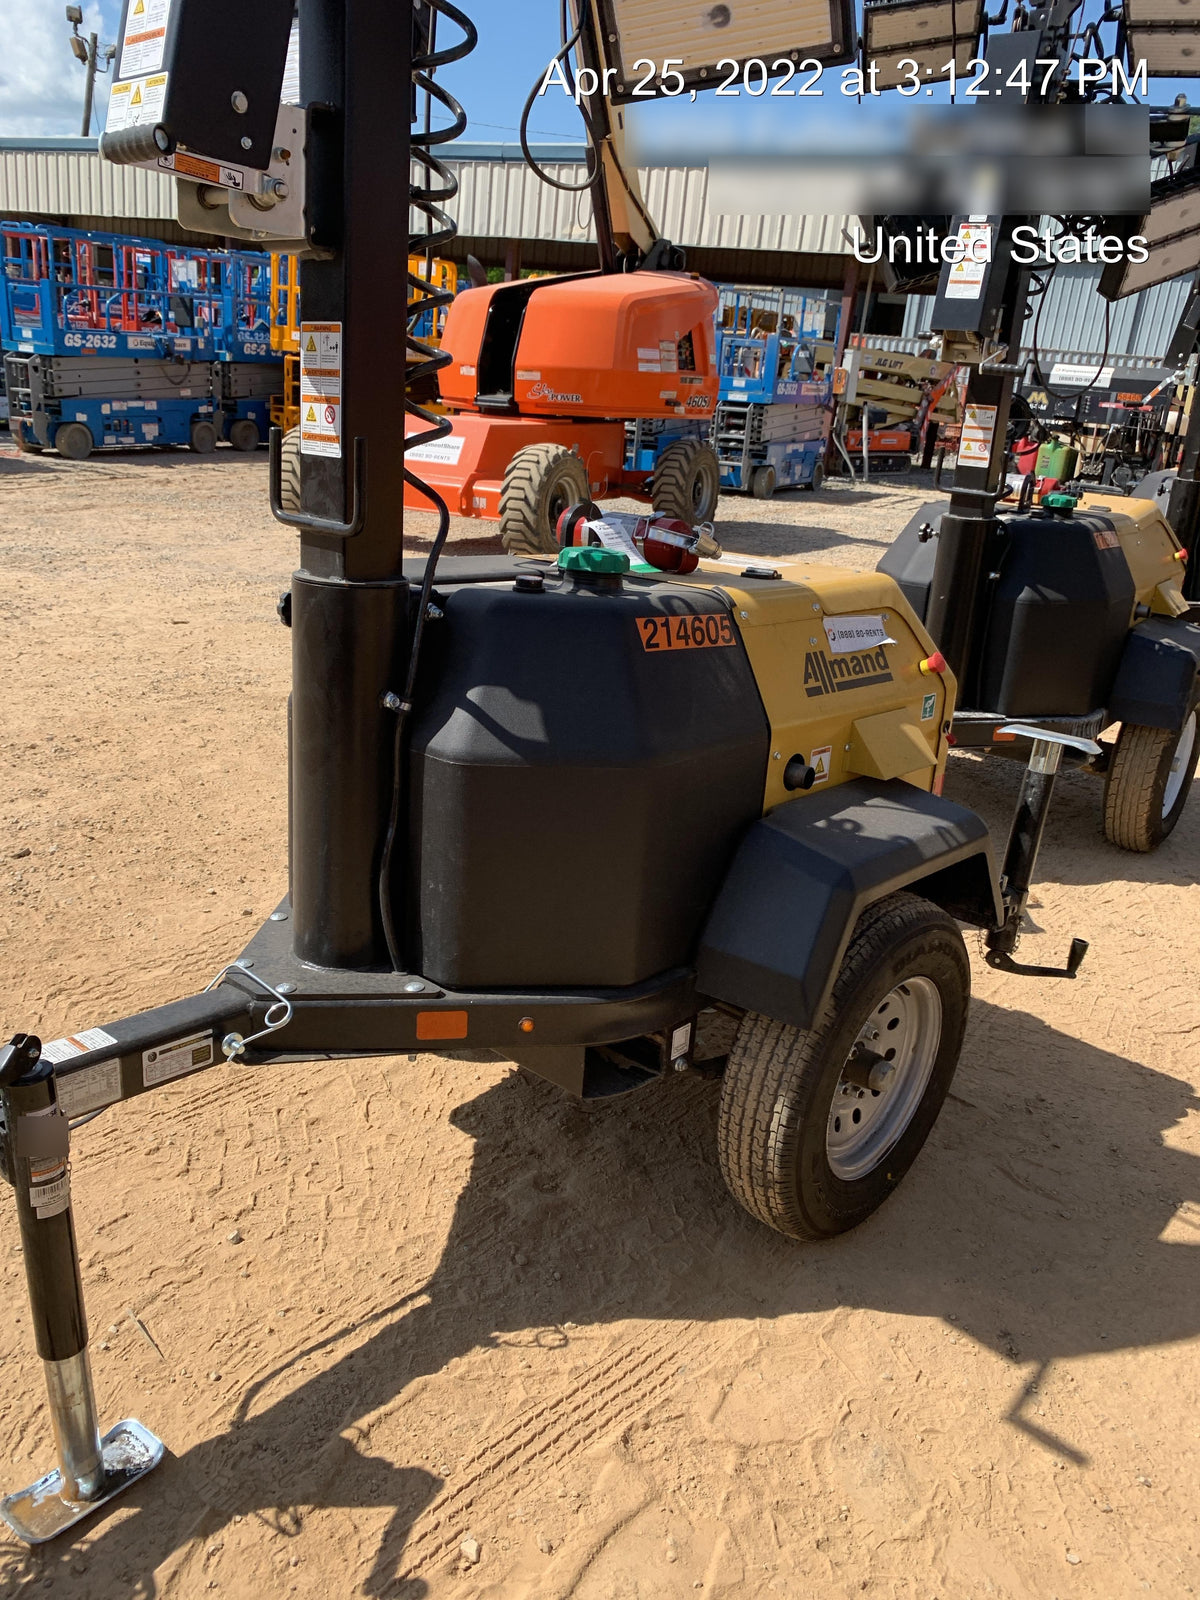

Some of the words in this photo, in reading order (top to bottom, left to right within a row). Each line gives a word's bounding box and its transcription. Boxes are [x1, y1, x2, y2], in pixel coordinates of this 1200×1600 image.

[64, 333, 117, 349] GS-2632
[875, 357, 889, 367] JLG
[889, 359, 904, 369] LIFT
[549, 393, 581, 402] POWER
[643, 615, 735, 649] 214605
[837, 628, 855, 640] (888)
[855, 628, 885, 639] 80-RENTS
[803, 643, 890, 694] Allmand
